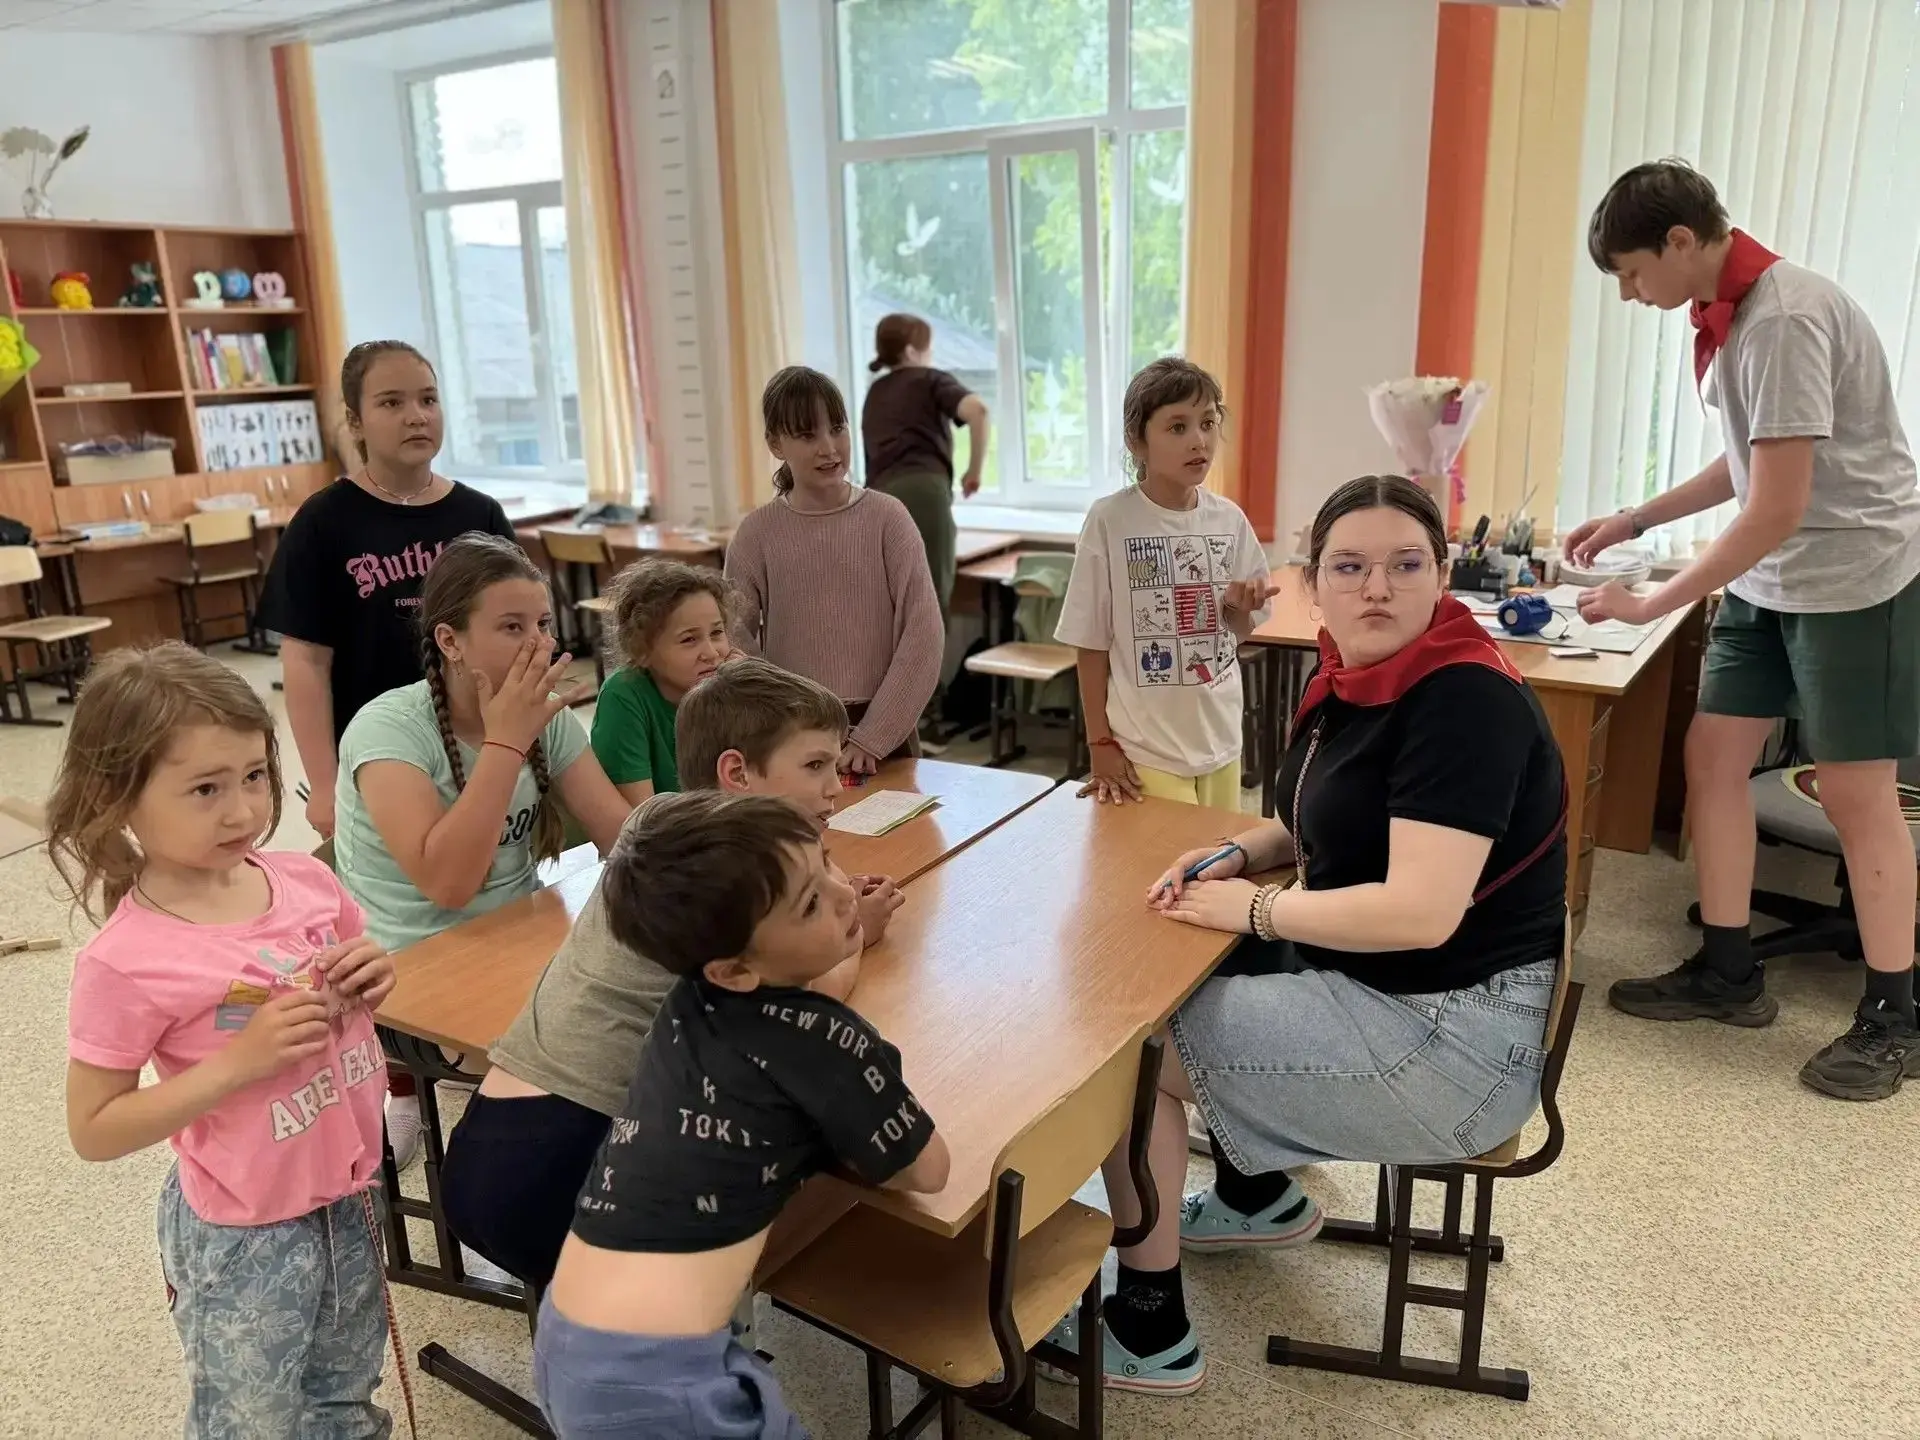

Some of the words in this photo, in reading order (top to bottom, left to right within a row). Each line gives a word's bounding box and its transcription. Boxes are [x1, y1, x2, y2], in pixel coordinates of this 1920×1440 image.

[826, 1017, 874, 1059] YOR
[863, 1065, 886, 1093] B
[270, 1066, 340, 1142] ARE
[697, 1194, 718, 1213] N
